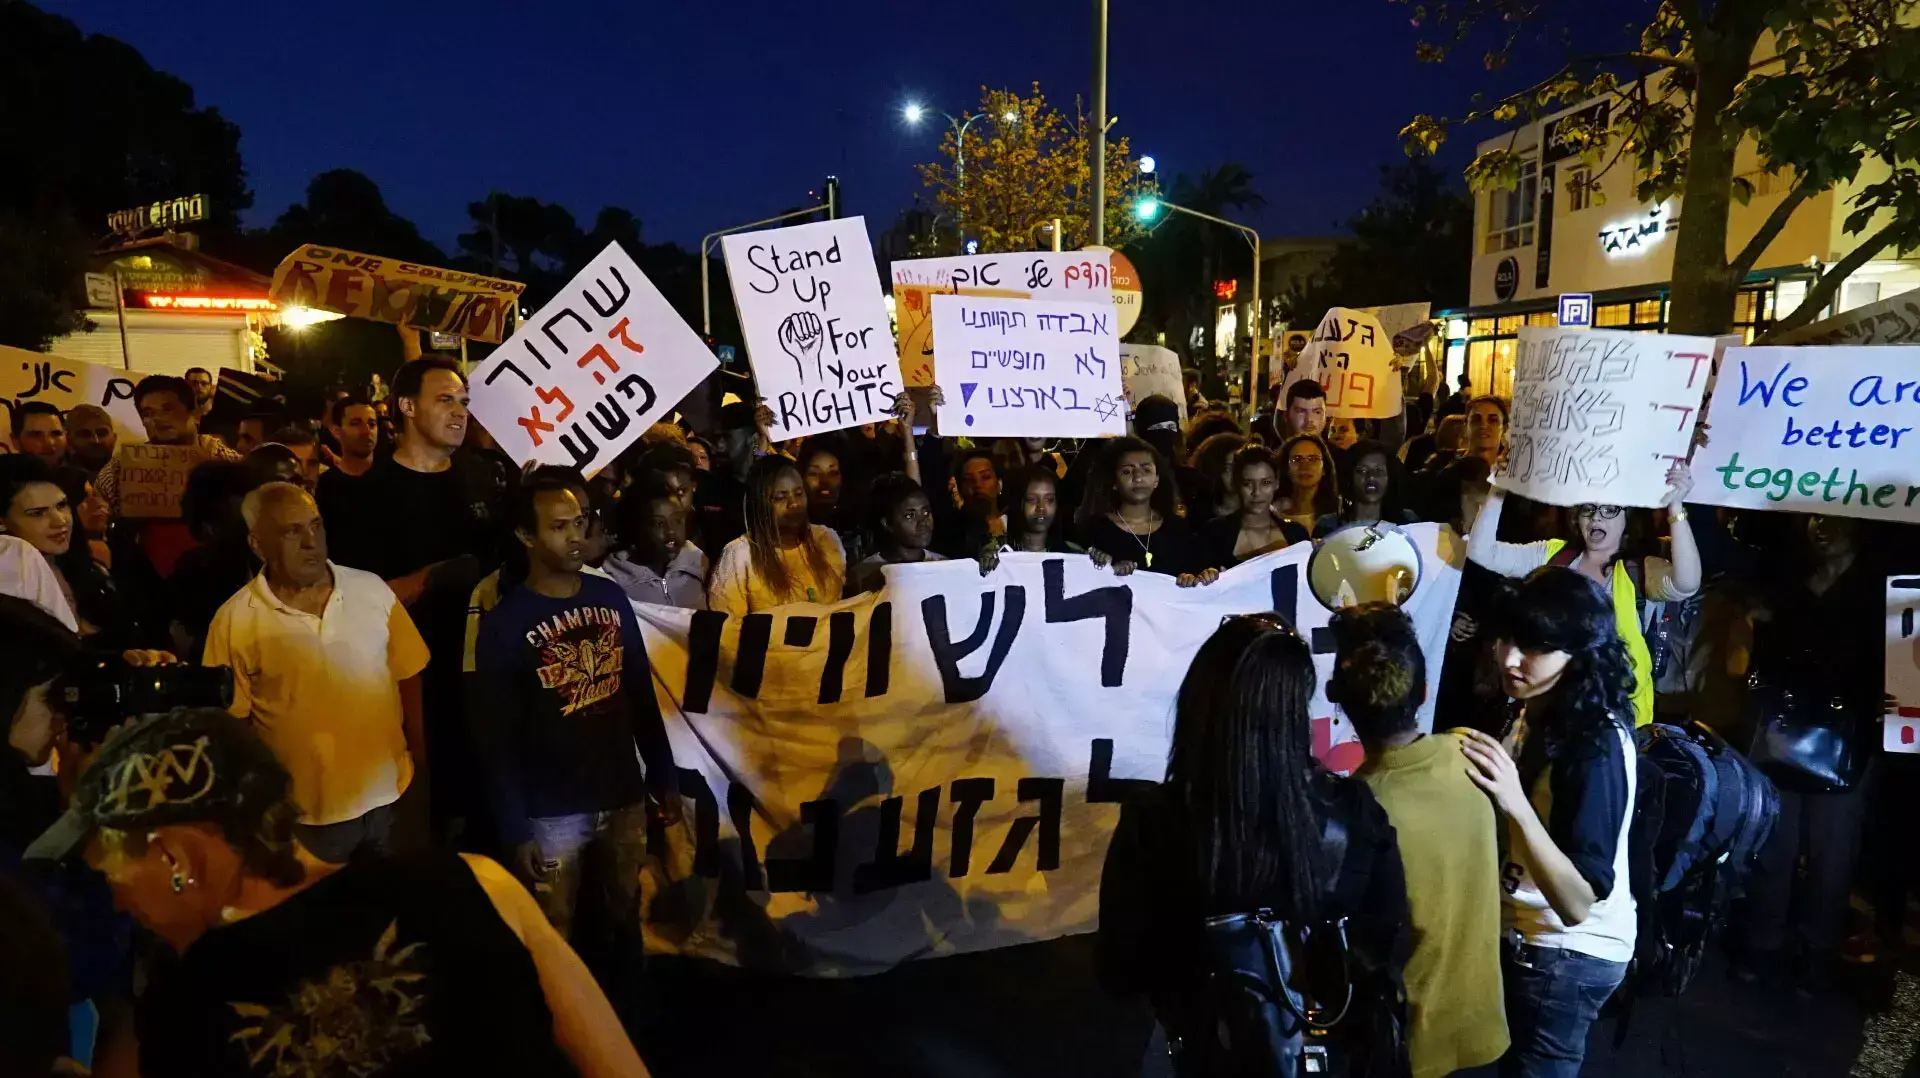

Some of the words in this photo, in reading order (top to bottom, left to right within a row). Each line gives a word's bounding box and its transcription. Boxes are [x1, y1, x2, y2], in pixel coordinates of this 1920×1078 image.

[1598, 221, 1659, 252] TATAMI
[306, 248, 382, 273] ONE
[748, 236, 842, 293] Stand
[1024, 259, 1053, 289] שלי
[1064, 261, 1108, 289] הדם
[792, 275, 831, 312] Up
[485, 266, 631, 386] שחור
[826, 317, 874, 355] For
[961, 307, 1027, 336] תקוותנו
[1036, 312, 1109, 336] אבדה
[577, 316, 645, 386] זה
[971, 349, 1045, 371] חופשיים
[1074, 346, 1106, 379] לא
[1317, 348, 1351, 371] היא
[1665, 349, 1710, 390] די
[1301, 372, 1375, 410] פש
[1738, 360, 1810, 409] We
[1849, 375, 1920, 408] ar
[517, 386, 576, 448] לא
[558, 373, 658, 471] פשע
[778, 381, 897, 432] RIGHTS
[1649, 400, 1694, 432] די
[1781, 416, 1914, 449] better
[1715, 451, 1920, 509] together
[526, 606, 622, 648] CHAMPION
[682, 558, 1133, 714] לשוויון
